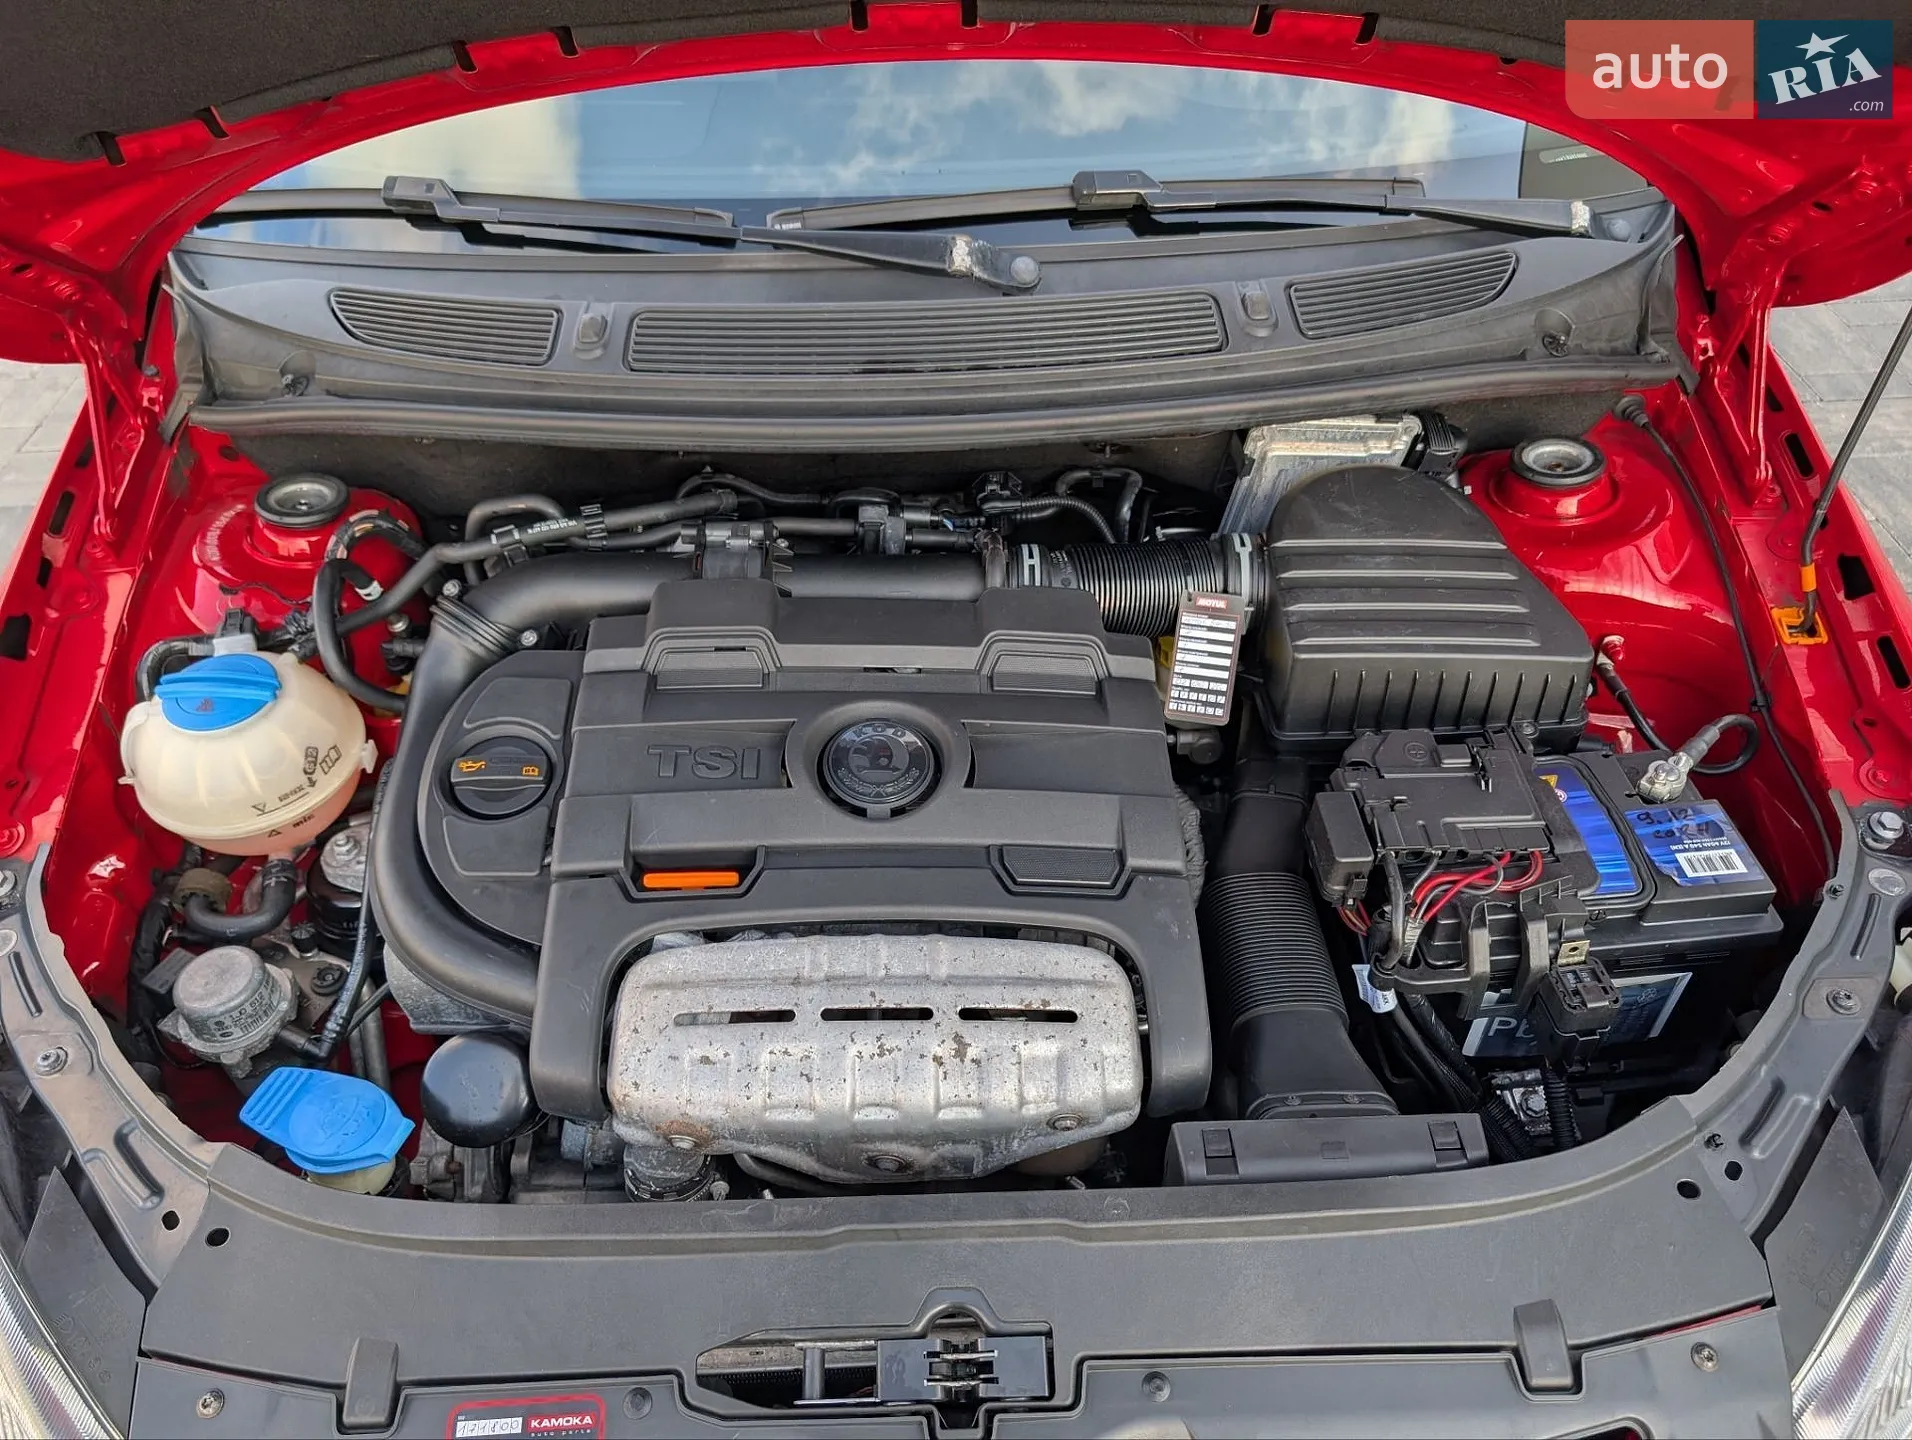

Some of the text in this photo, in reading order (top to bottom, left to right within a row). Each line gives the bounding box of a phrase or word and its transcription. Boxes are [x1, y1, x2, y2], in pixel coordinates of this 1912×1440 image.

[1197, 598, 1227, 609] MOTUL
[647, 744, 760, 779] TSI
[530, 1415, 593, 1429] KAMOKA
